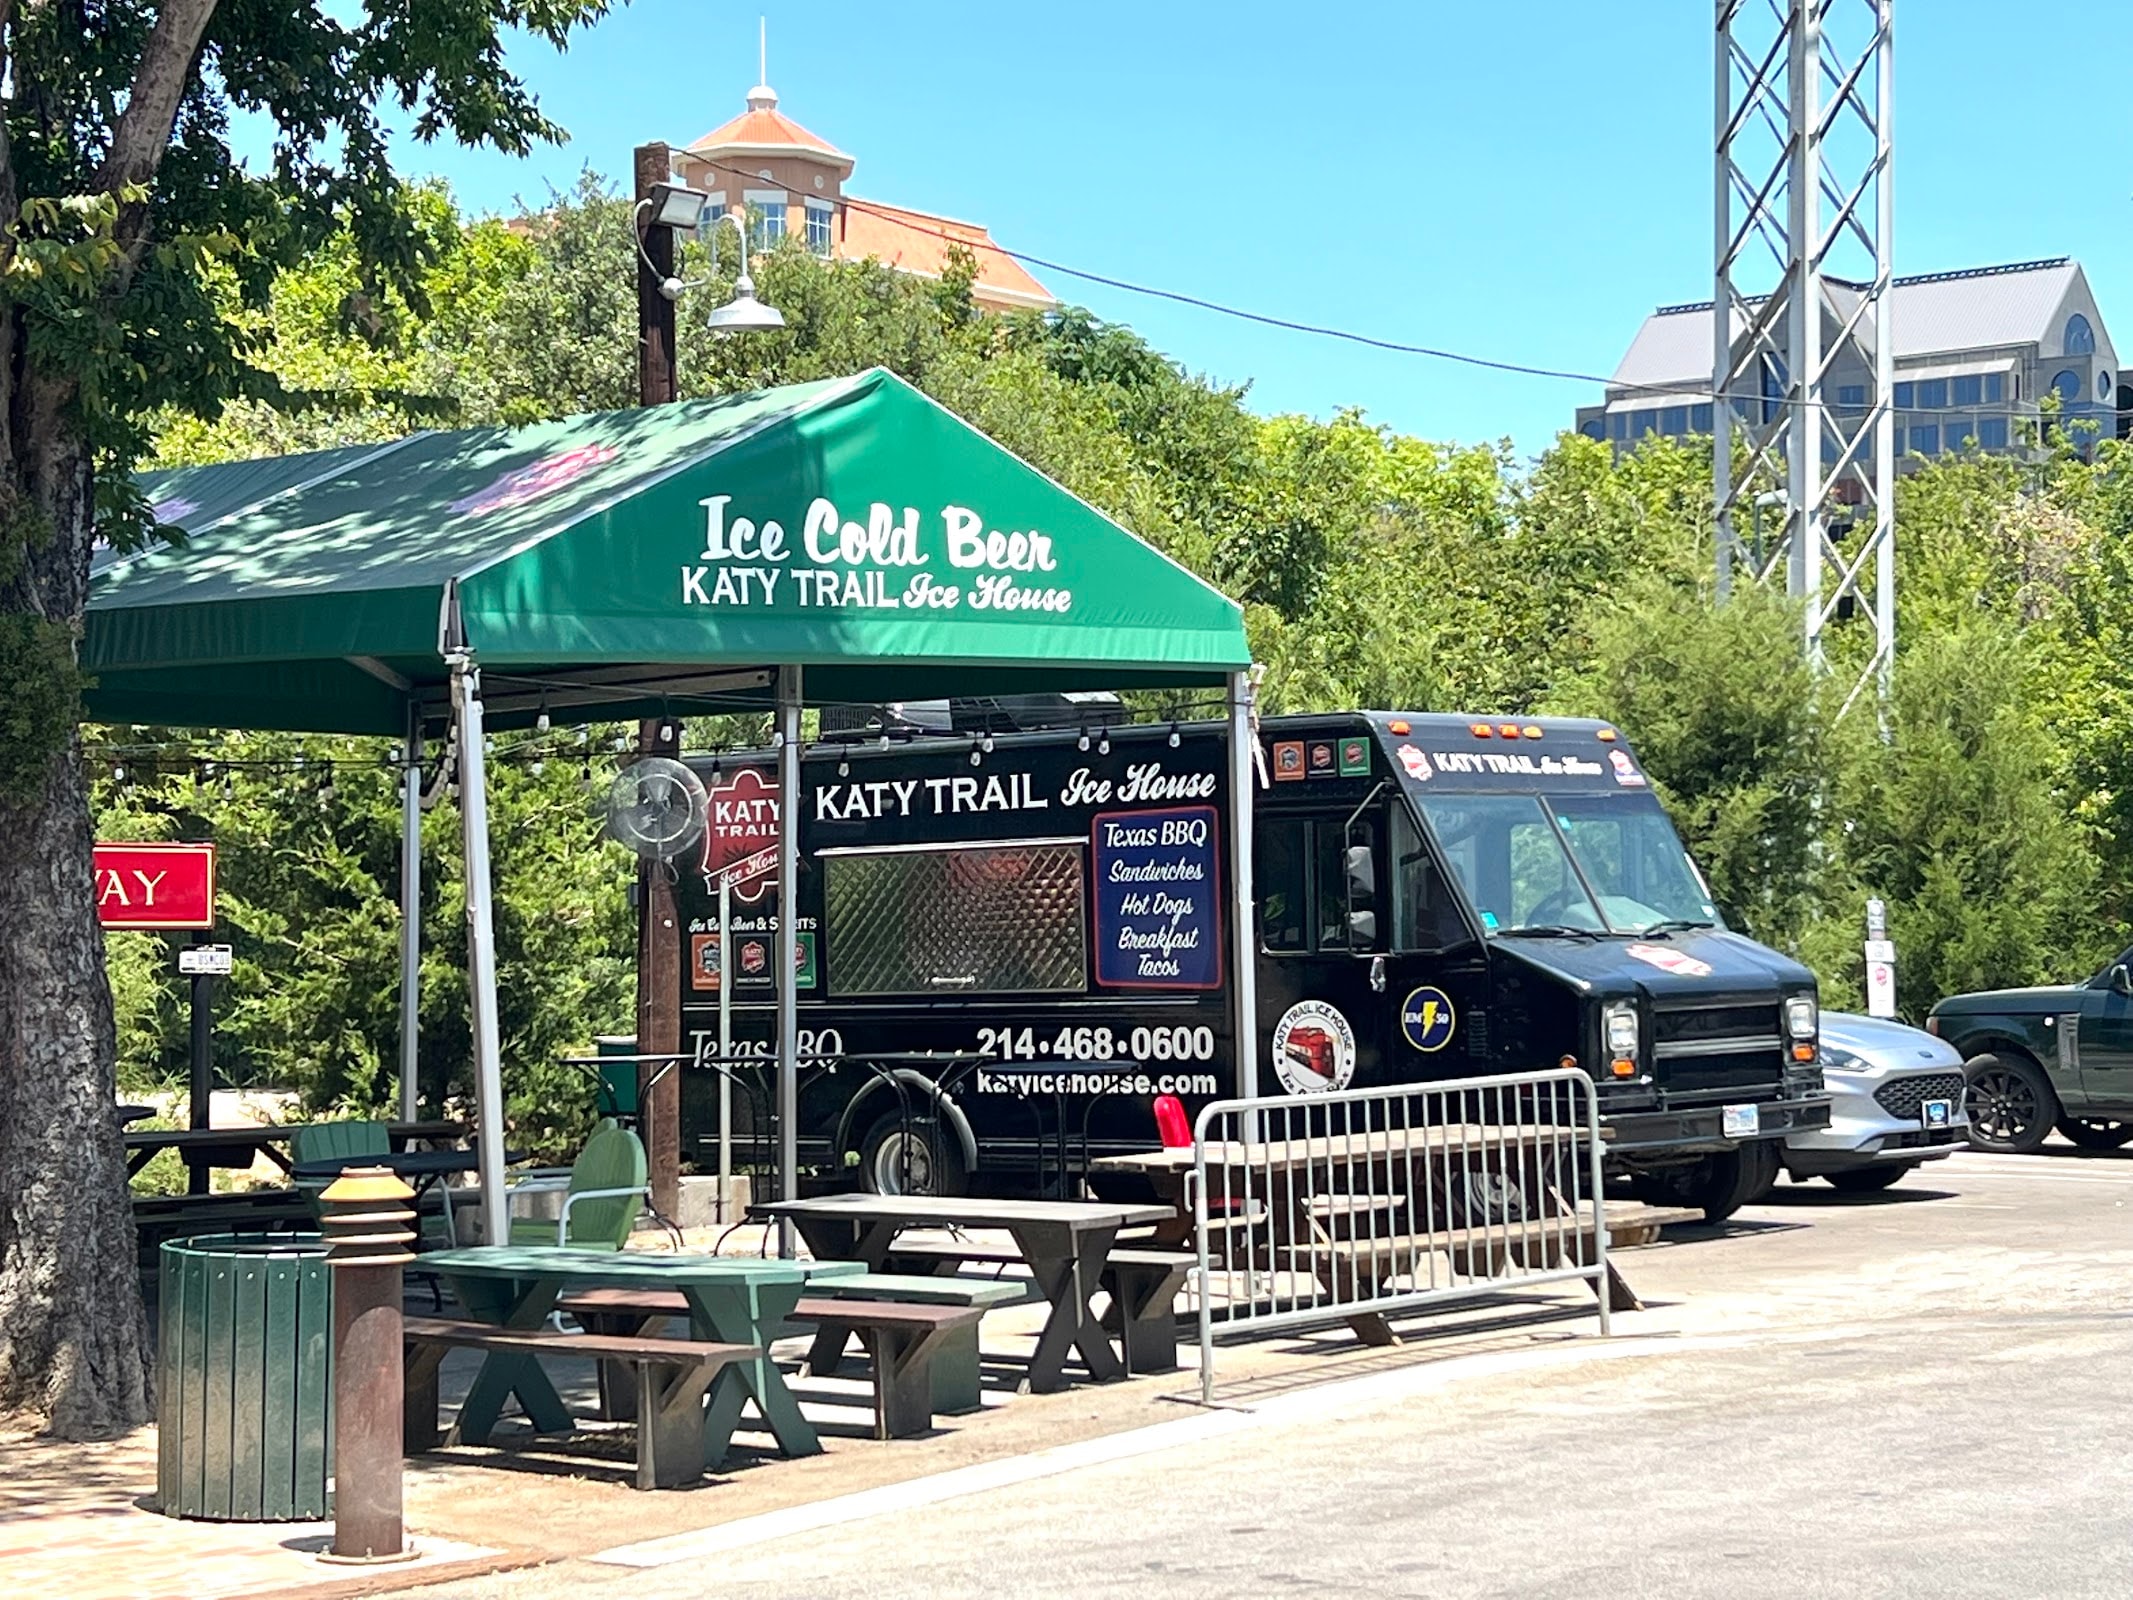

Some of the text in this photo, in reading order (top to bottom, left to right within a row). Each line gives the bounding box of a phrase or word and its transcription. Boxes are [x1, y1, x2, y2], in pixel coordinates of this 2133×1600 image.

[698, 494, 1058, 572] Ice Cold Beer
[681, 566, 1073, 613] KATY TRAIL Ice House
[1433, 752, 1487, 773] KATY
[1483, 754, 1542, 775] TRAIL
[816, 762, 1216, 820] KATY TRAIL Ice House
[714, 798, 780, 837] KATY TRAIL
[1104, 818, 1208, 848] Texas BBQ
[1108, 856, 1205, 883] Sandwiches
[94, 869, 168, 906] AY
[756, 917, 767, 931] &
[1120, 891, 1194, 925] Hot Dogs
[1118, 924, 1199, 957] Breakfast
[1137, 953, 1180, 977] Tacos
[1276, 1004, 1353, 1052] KATY TRAIL ICE HOUSE
[689, 1028, 843, 1074] Teas BQ
